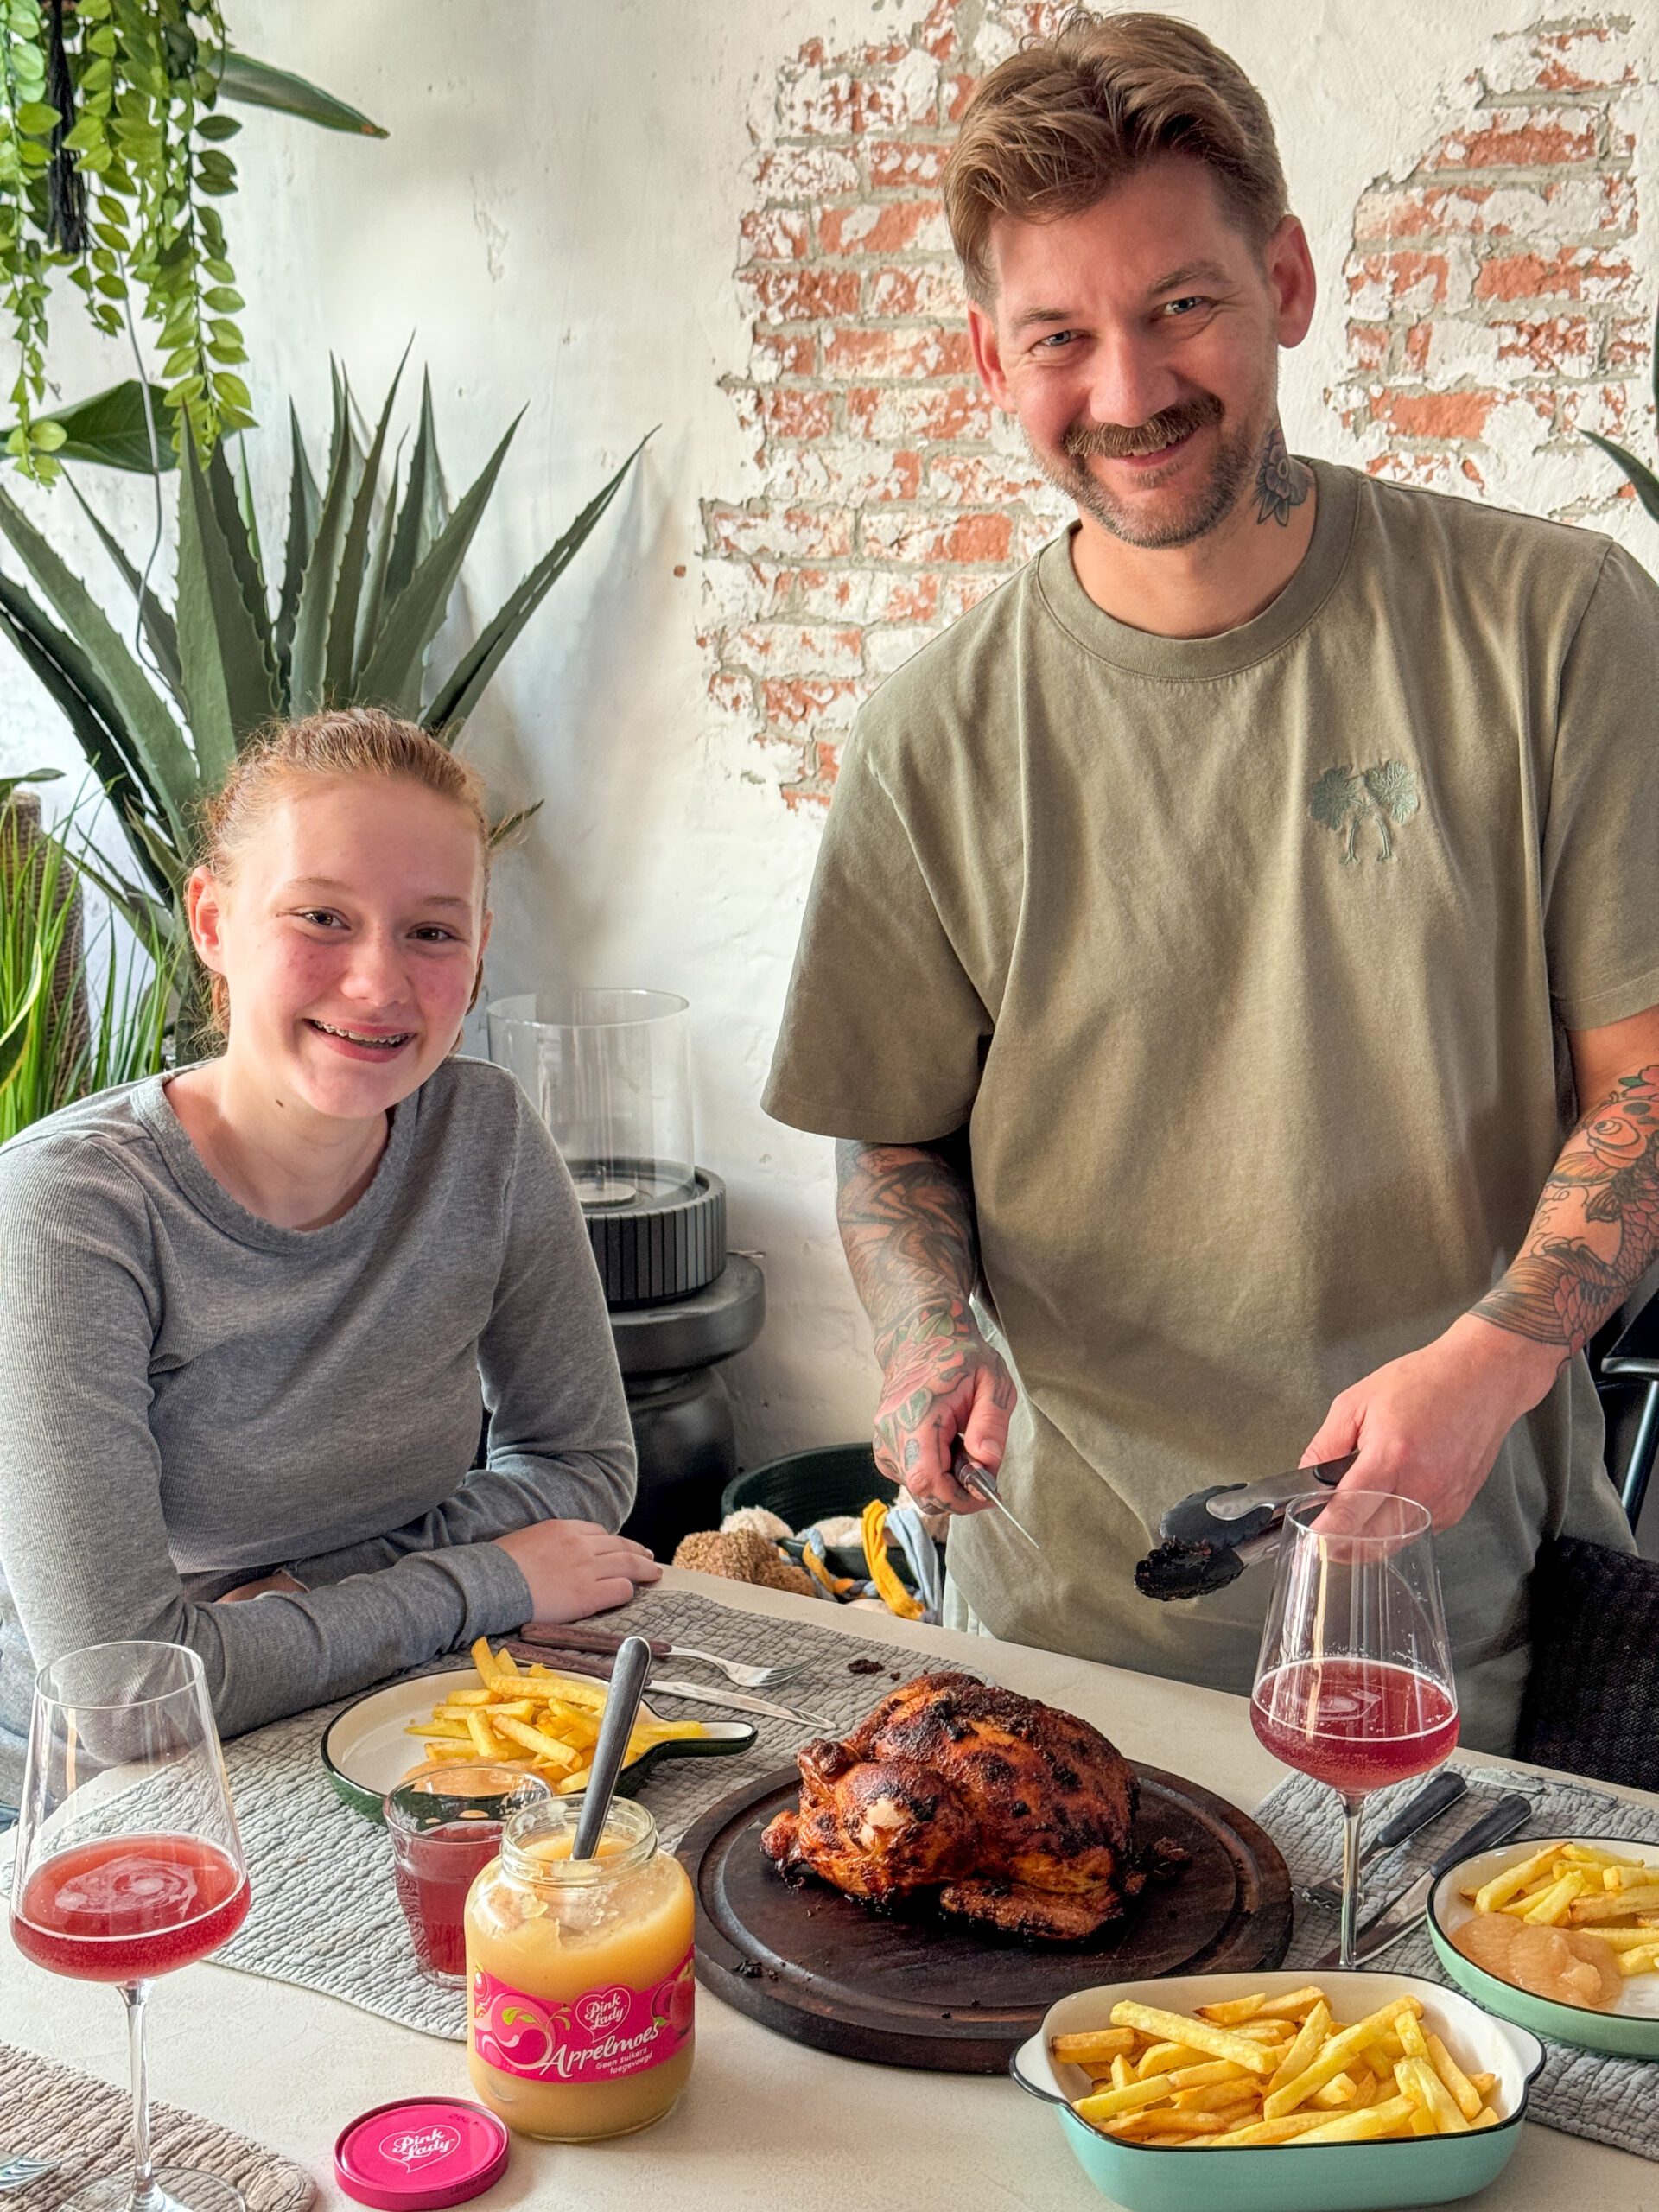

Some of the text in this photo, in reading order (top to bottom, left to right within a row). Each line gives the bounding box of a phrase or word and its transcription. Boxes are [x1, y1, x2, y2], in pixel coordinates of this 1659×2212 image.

[584, 1993, 621, 2020] Pink
[589, 2006, 624, 2030] Lady
[539, 2021, 659, 2077] Appelmoes
[595, 2047, 648, 2070] Geen suikers
[610, 2050, 653, 2075] toegevoegd
[391, 2127, 446, 2153] Pink
[401, 2139, 452, 2162] Lady
